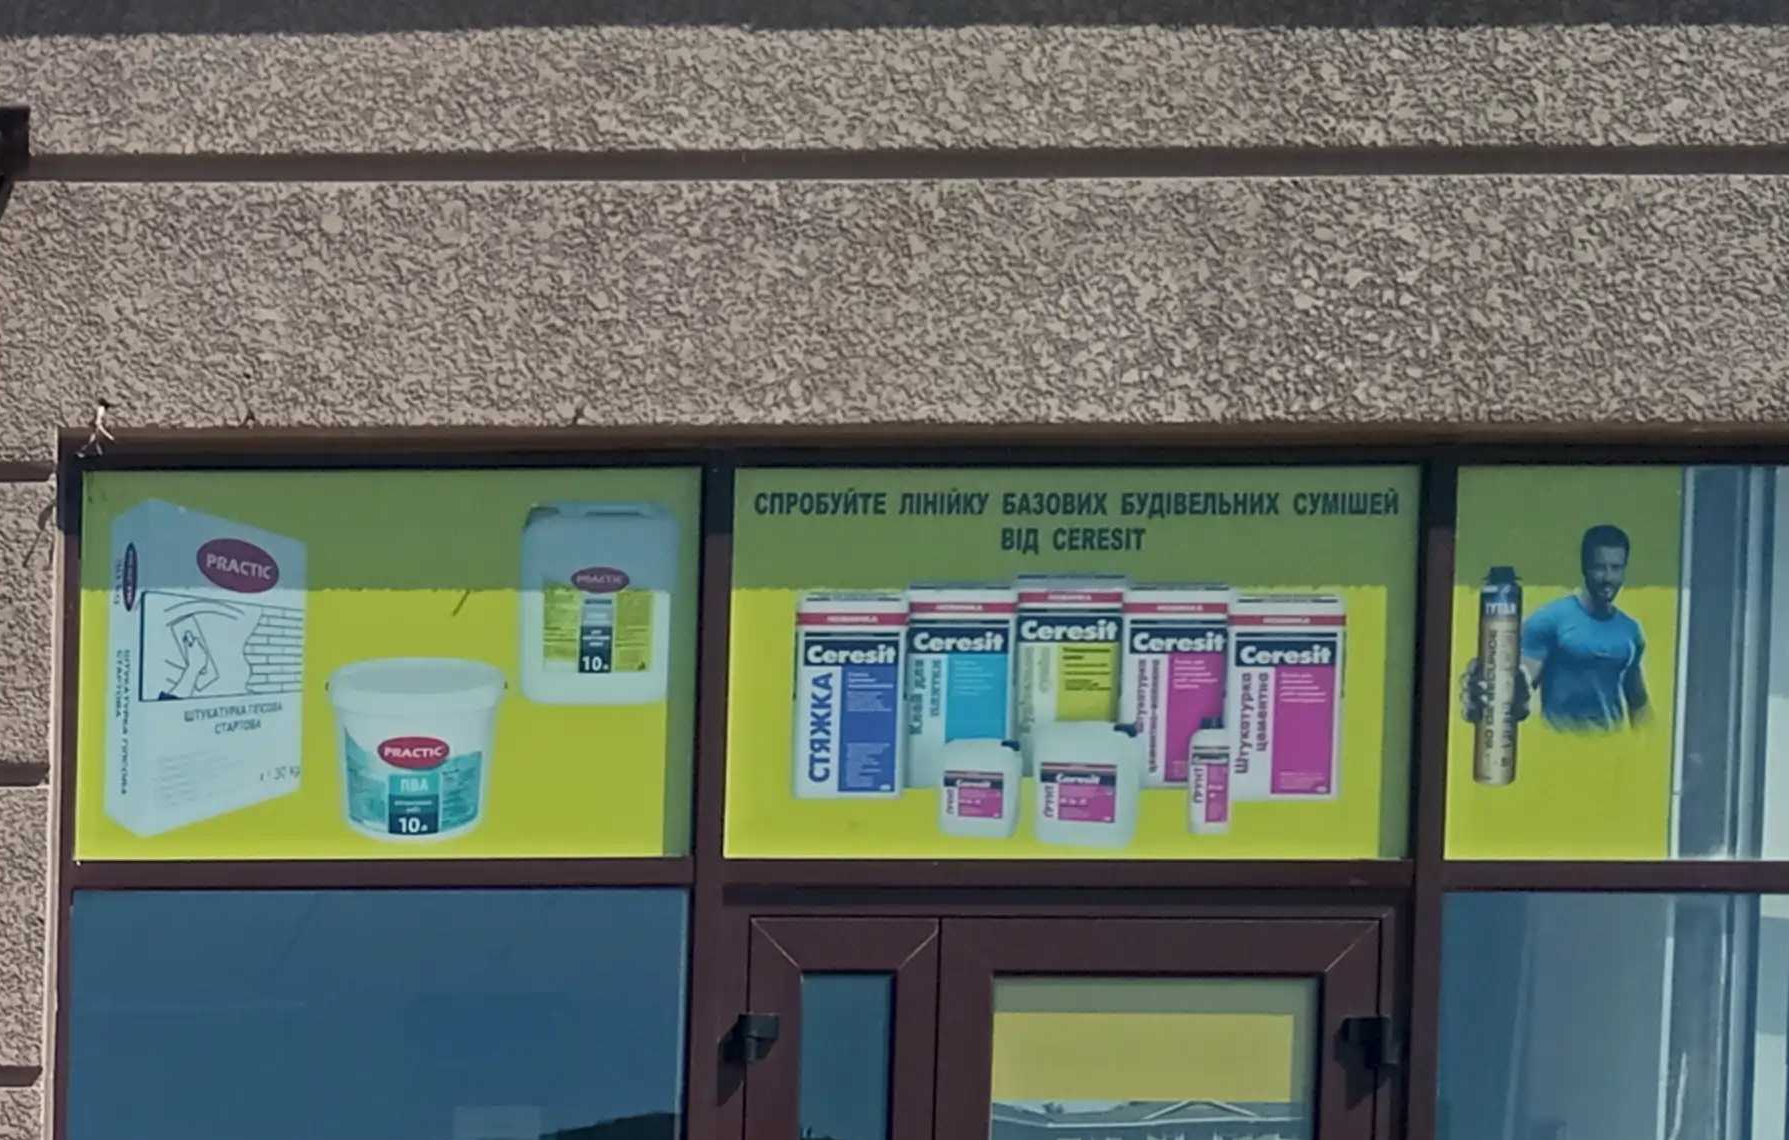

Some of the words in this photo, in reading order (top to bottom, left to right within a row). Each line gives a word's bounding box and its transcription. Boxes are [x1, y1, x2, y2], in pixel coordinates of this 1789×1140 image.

[754, 488, 887, 515] СПРОБУЙТЕ
[898, 488, 989, 515] ЛІНІЙКУ
[1002, 492, 1107, 515] БАЗОВИХ
[1121, 492, 1279, 518] БУДІВЕЛЬНИХ
[1293, 488, 1399, 515] СУМІШЕЙ
[1001, 528, 1039, 554] ВІД
[1053, 528, 1146, 551] CERESIT
[206, 553, 272, 580] PRACTIC
[1020, 619, 1118, 640] Ceresit
[914, 632, 1004, 651] Ceresit
[1133, 632, 1225, 651] Ceresit
[807, 645, 896, 664] Ceresit
[1240, 646, 1331, 664] Ceresit
[808, 672, 834, 782] СТЯЖКА
[1234, 672, 1253, 774] Штукатурка
[384, 745, 445, 759] PRACTIC
[400, 778, 428, 792] ПВА
